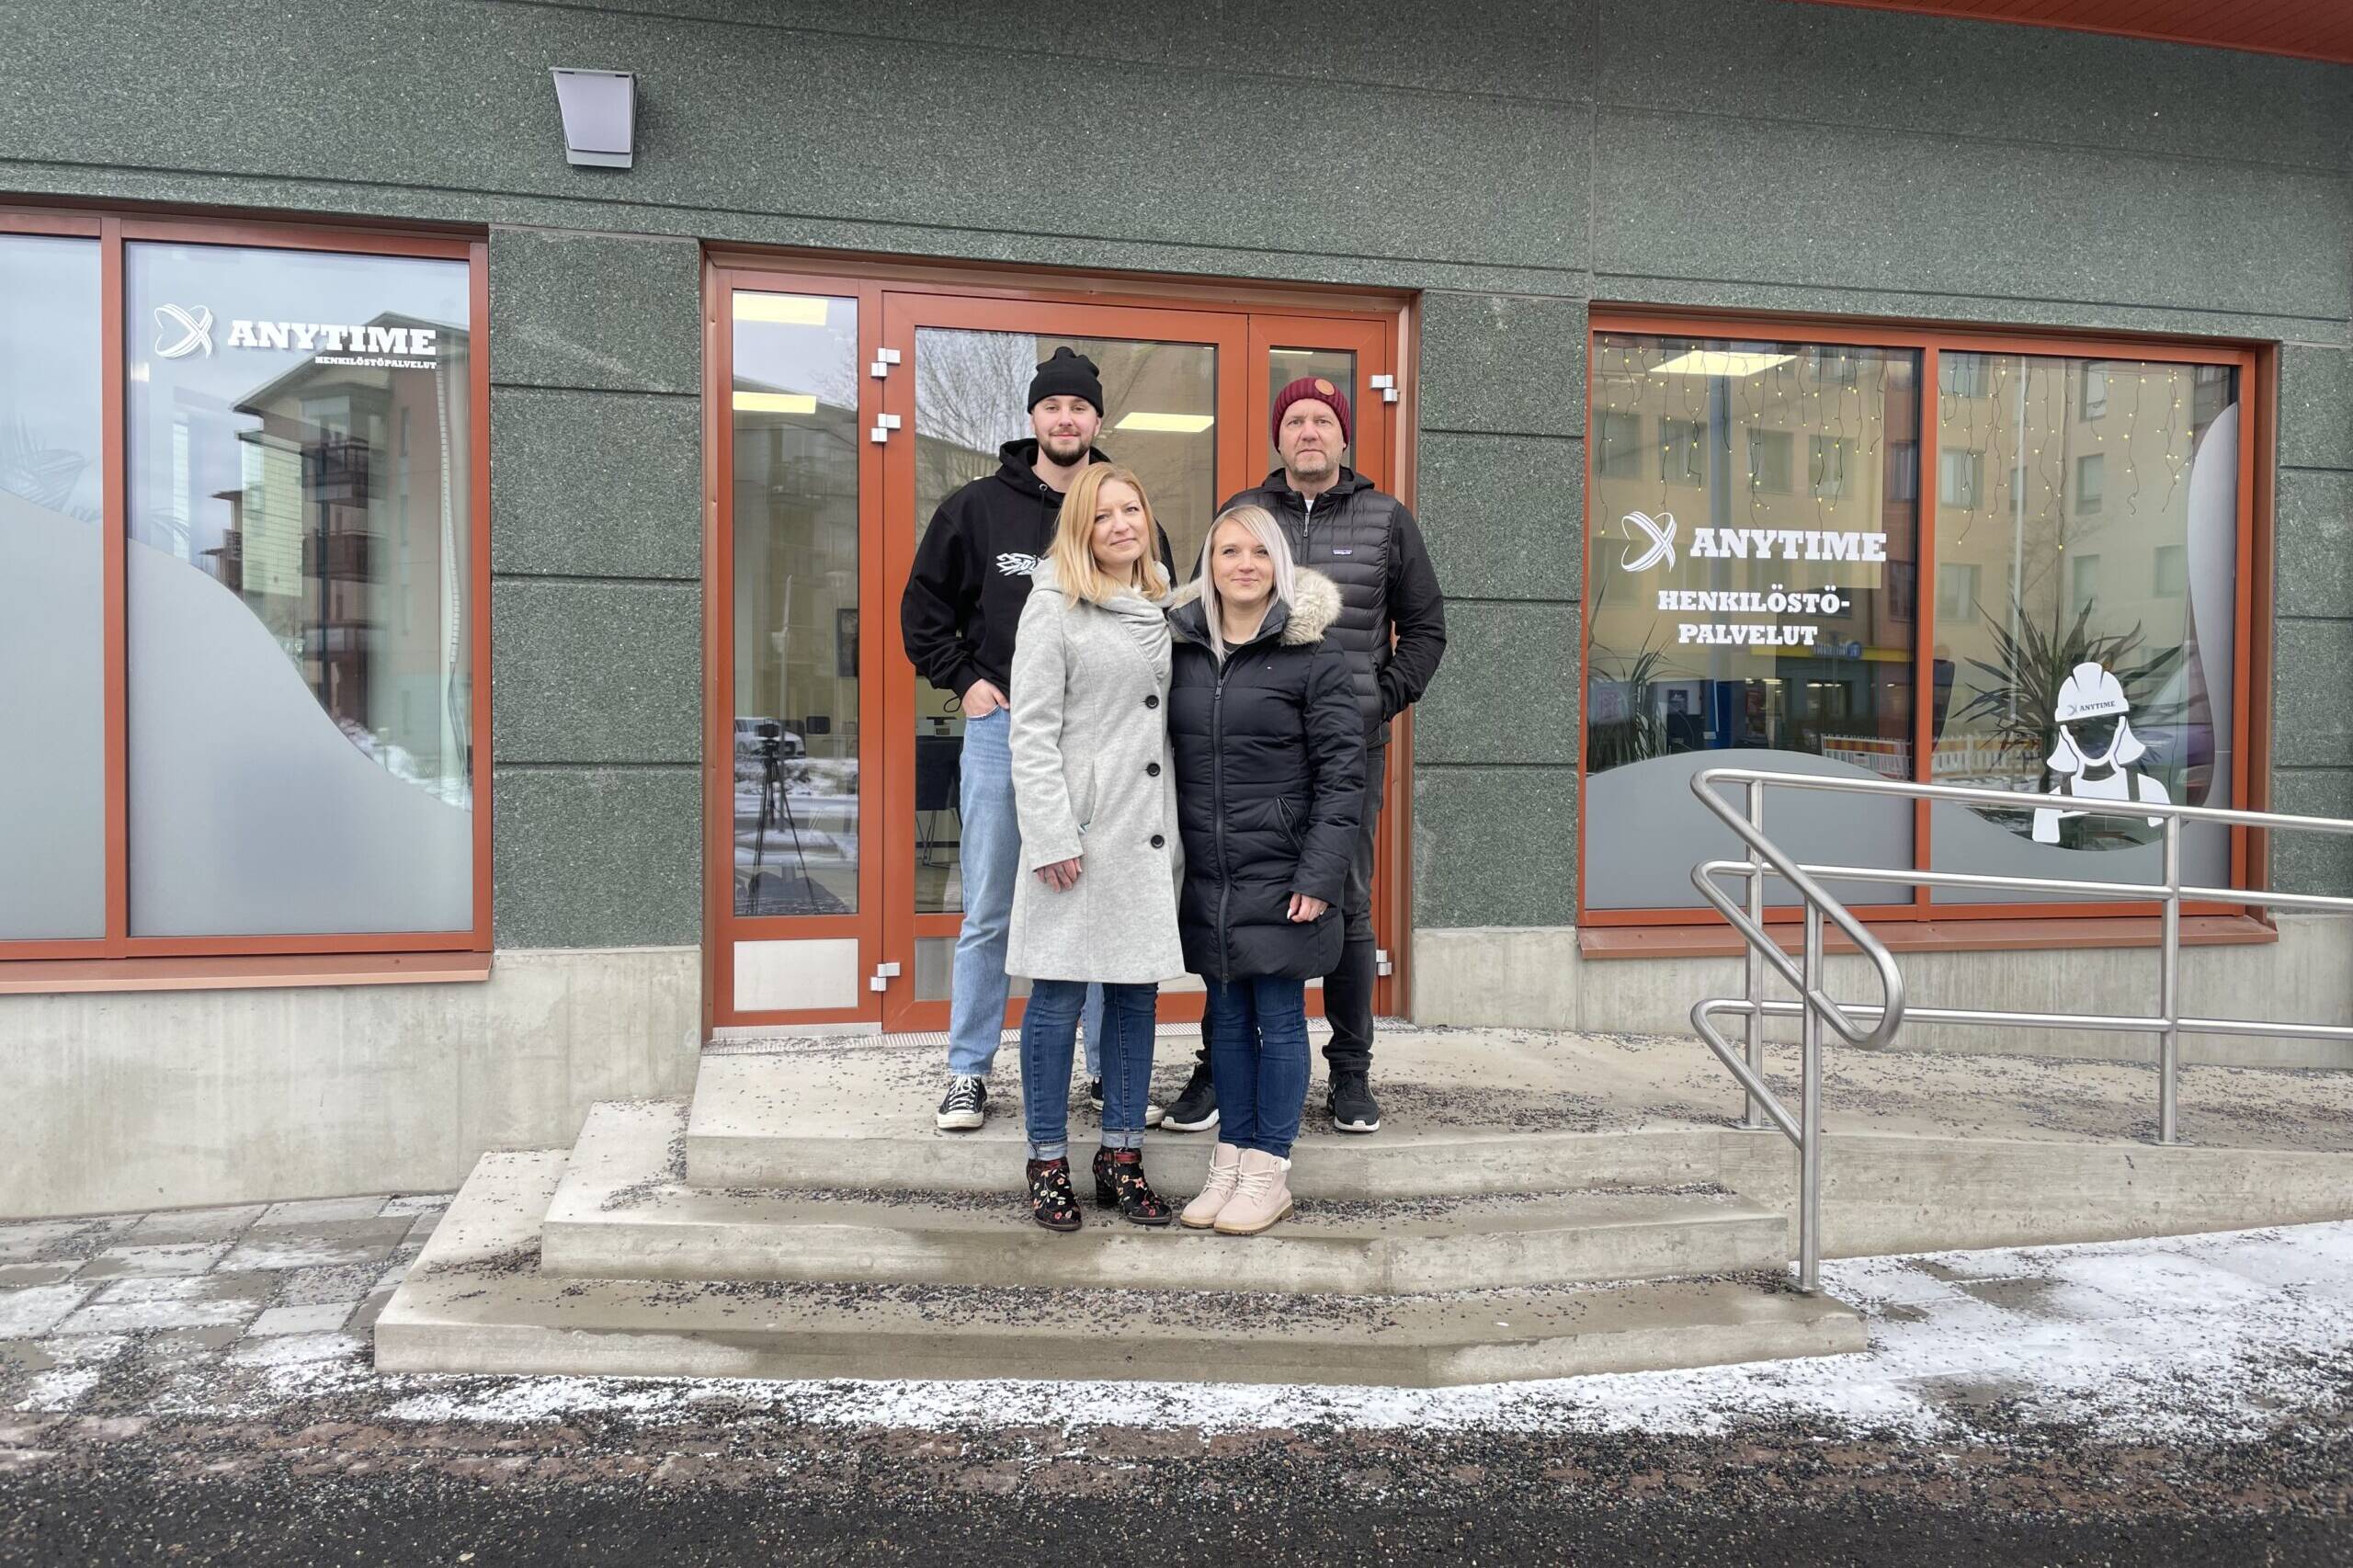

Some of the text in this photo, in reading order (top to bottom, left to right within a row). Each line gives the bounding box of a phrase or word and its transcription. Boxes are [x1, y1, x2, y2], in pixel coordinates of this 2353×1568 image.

[228, 320, 437, 356] ANYTIME
[314, 355, 438, 369] HENKILÖSTÖPALVELUT
[1689, 528, 1887, 562] ANYTIME
[1658, 584, 1850, 614] HENKILÖSTÖ-
[1677, 623, 1818, 646] PALVELUT
[2079, 700, 2116, 711] ANYTIME
